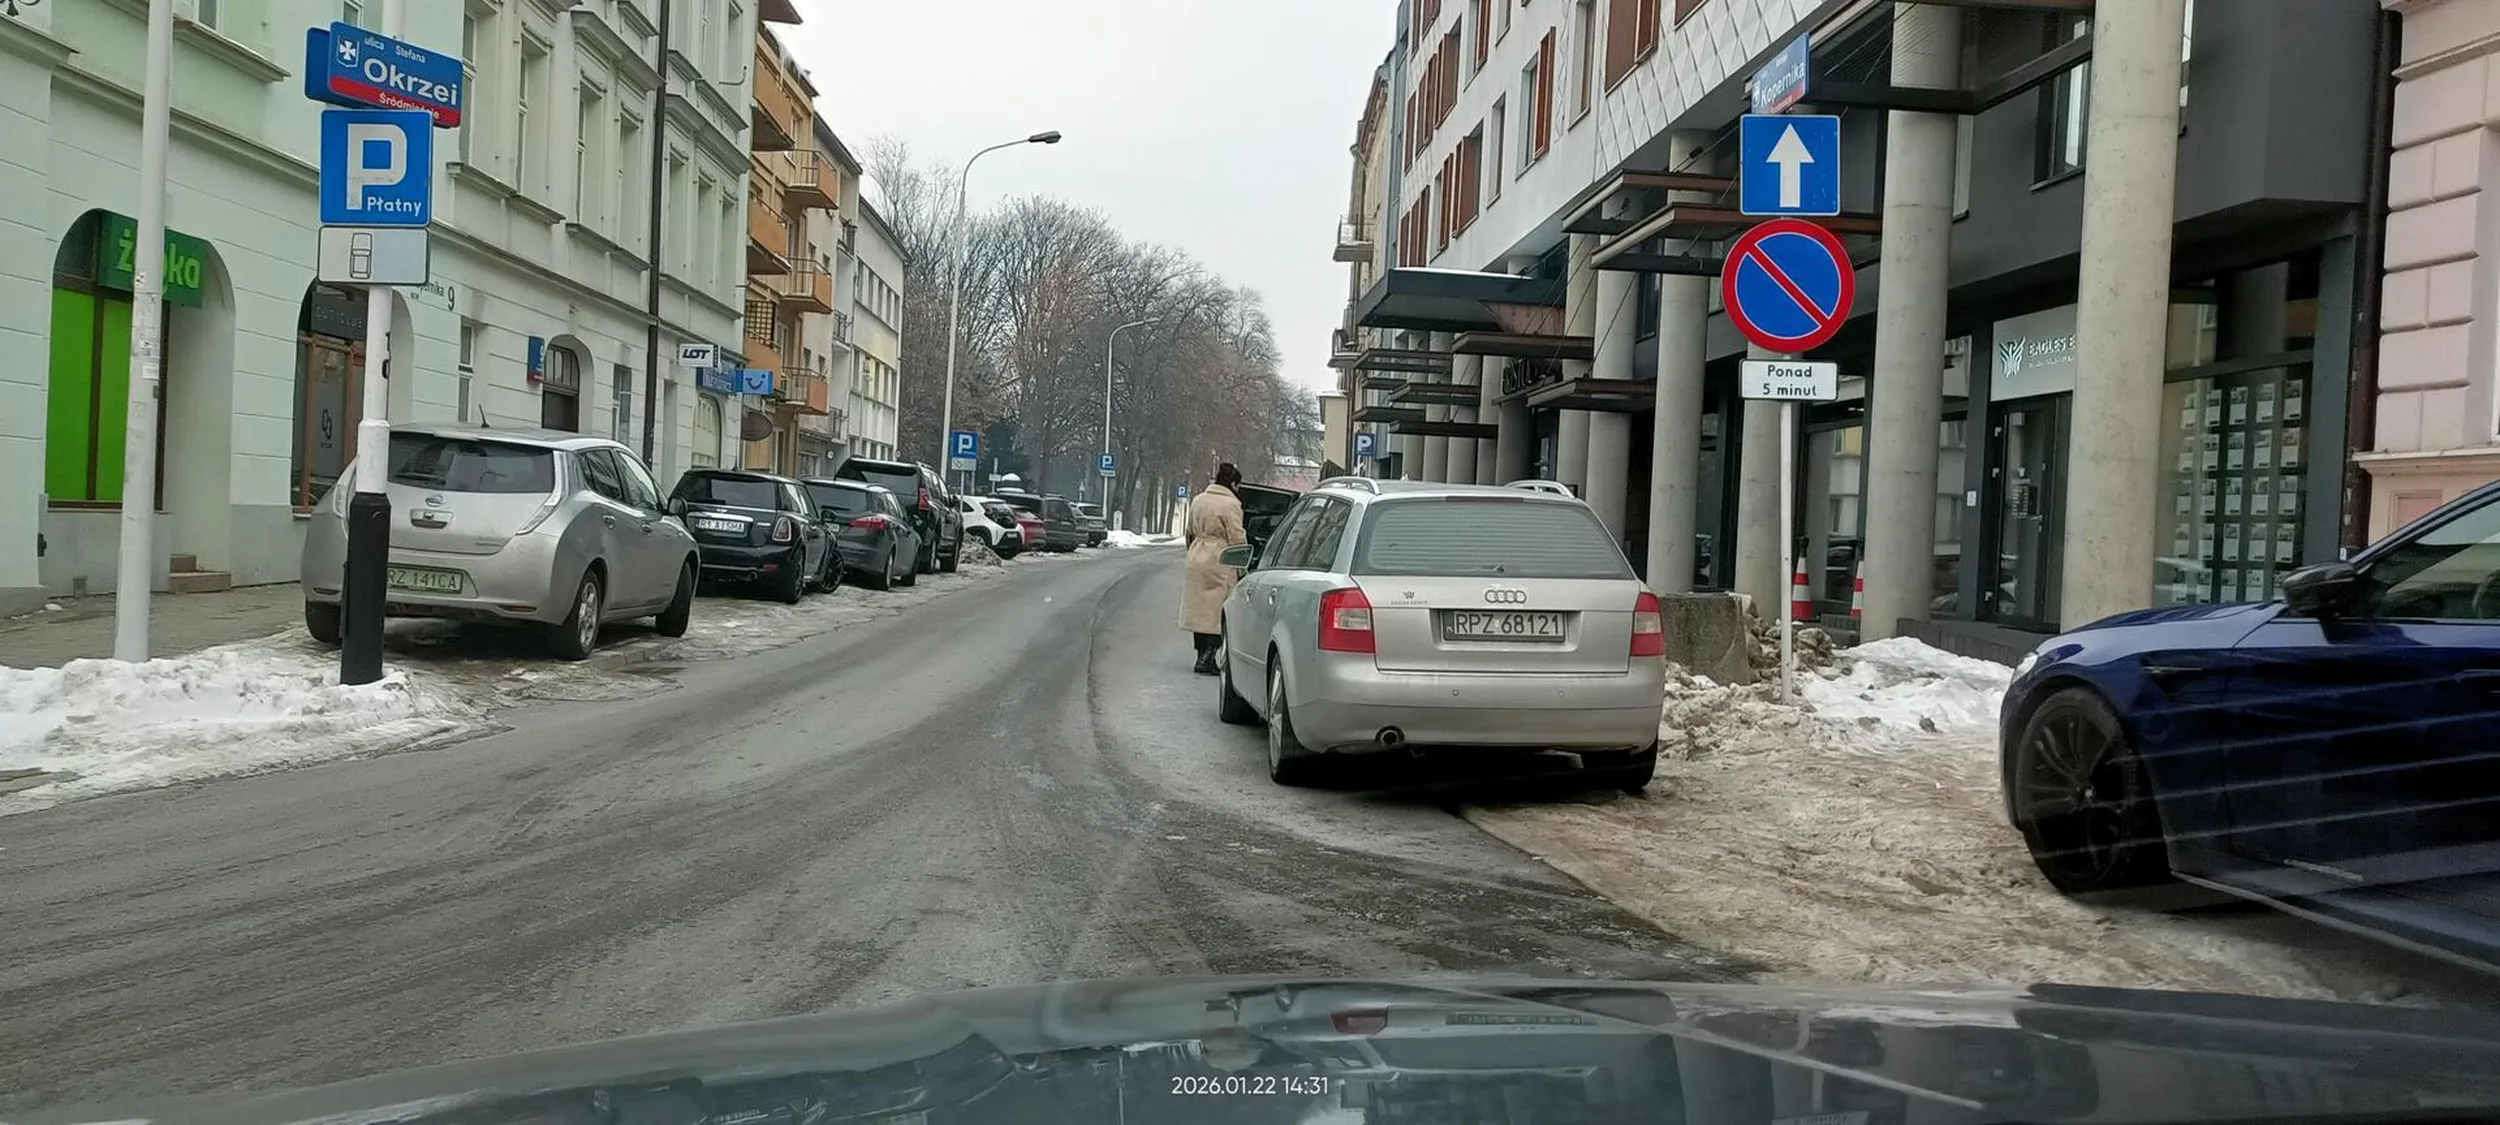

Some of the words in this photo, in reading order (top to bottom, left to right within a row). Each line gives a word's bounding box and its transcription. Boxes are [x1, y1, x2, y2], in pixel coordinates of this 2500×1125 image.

[395, 45, 425, 63] Stefana
[364, 58, 457, 105] Okrzei
[346, 123, 408, 210] P
[367, 196, 422, 217] Płatny
[447, 286, 455, 311] 9
[682, 348, 710, 359] LOT
[2029, 338, 2066, 357] EAGLES
[1768, 364, 1812, 377] Ponad
[1763, 383, 1771, 395] 5
[958, 434, 973, 454] P
[1455, 613, 1494, 633] RPZ
[1501, 614, 1559, 634] 68121
